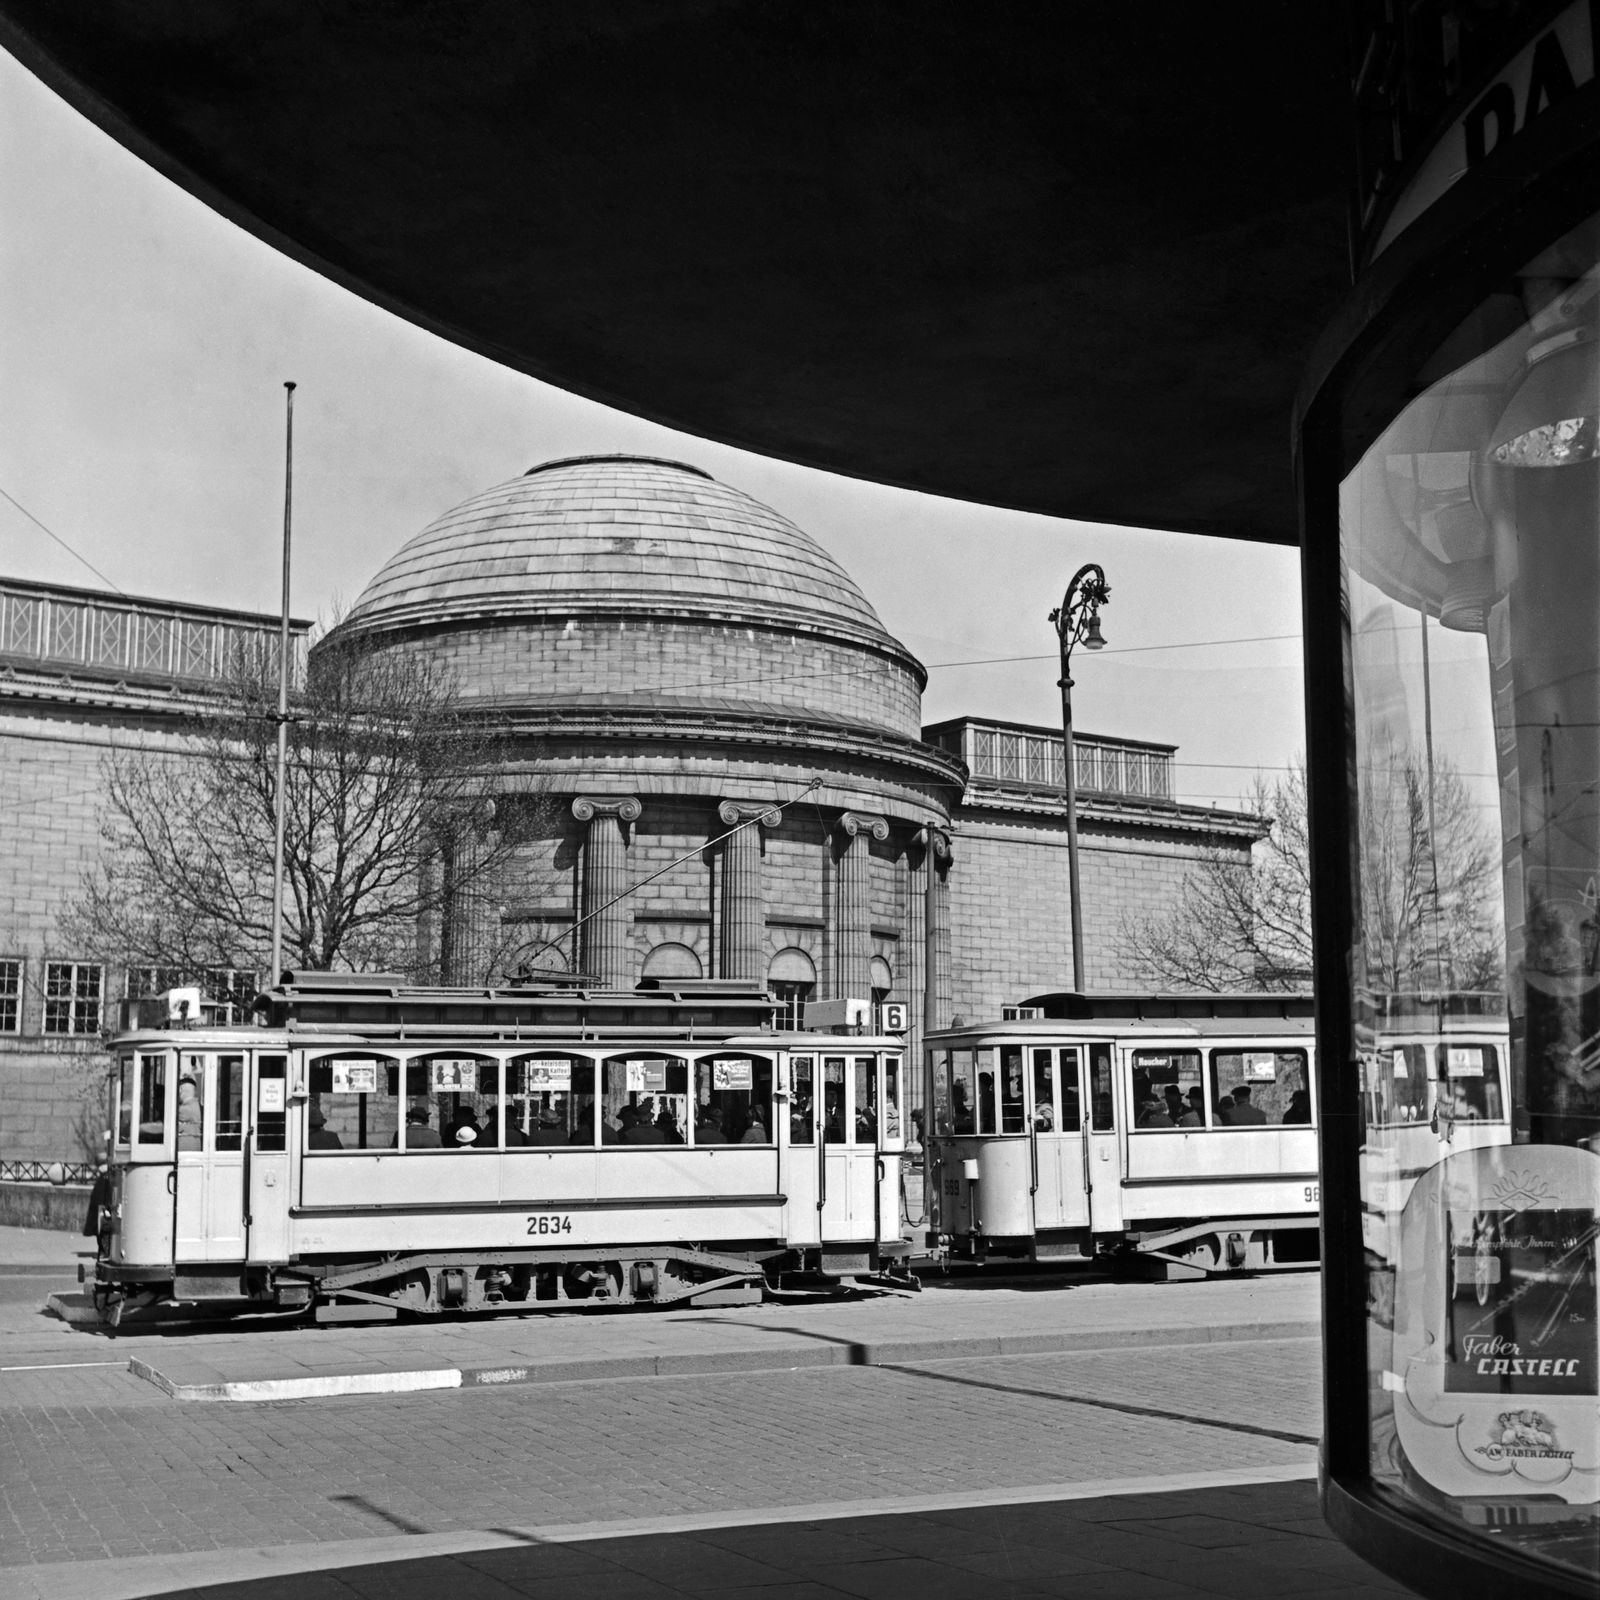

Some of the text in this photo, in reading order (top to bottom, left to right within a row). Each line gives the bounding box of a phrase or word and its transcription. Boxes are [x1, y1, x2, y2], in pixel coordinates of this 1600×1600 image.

[888, 1005, 901, 1028] 6
[527, 1215, 572, 1235] 2634
[1463, 1334, 1522, 1362] Faber
[1477, 1358, 1580, 1377] CASTELL
[1506, 1448, 1537, 1458] FABER
